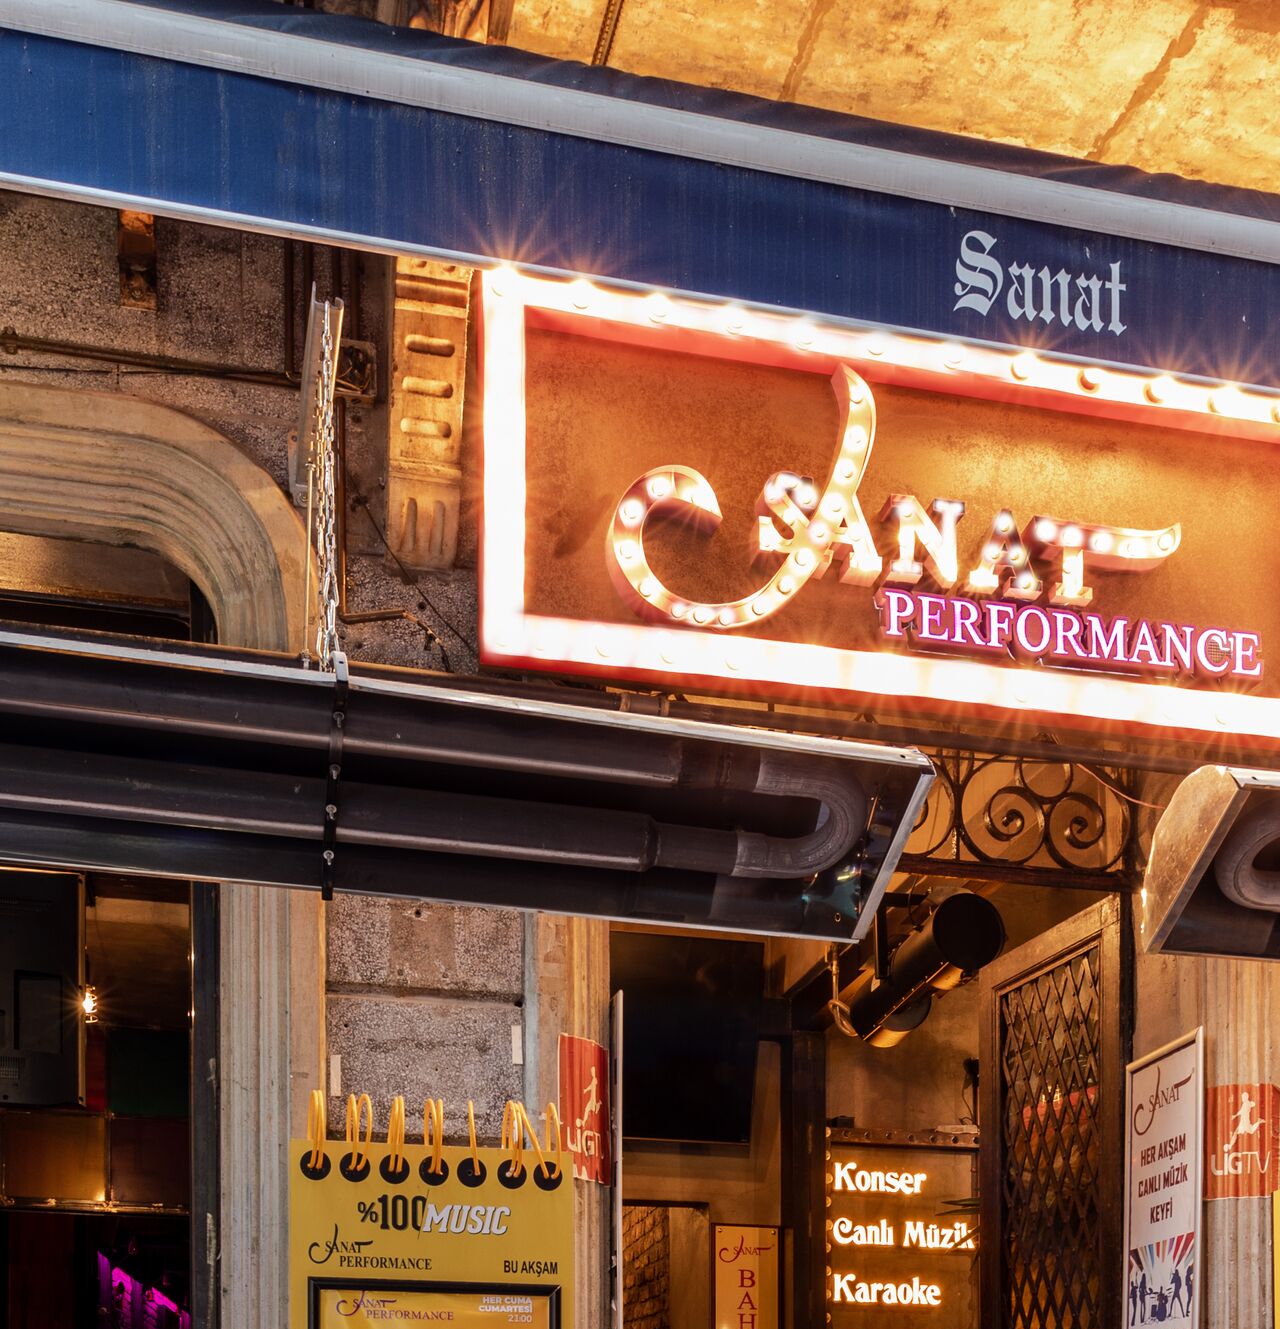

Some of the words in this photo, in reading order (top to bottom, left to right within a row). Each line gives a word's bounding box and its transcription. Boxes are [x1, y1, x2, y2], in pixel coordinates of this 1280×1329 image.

[953, 229, 1128, 335] Sanat
[607, 362, 1181, 628] SANAT
[884, 588, 1265, 677] PERFORMANCE
[1133, 1065, 1195, 1136] SANAT
[1140, 1145, 1156, 1167] HER
[1157, 1132, 1187, 1161] AKŞAM
[833, 1161, 927, 1194] Konser
[1138, 1175, 1161, 1198] CANLI
[1161, 1162, 1188, 1191] MÜZİK
[422, 1203, 512, 1236] MUSIC
[1149, 1200, 1173, 1225] KEYFİ
[308, 1223, 374, 1264] SANAT
[719, 1234, 772, 1263] SANAT
[832, 1217, 895, 1246] Canlı
[902, 1220, 976, 1249] Müzik
[339, 1255, 432, 1271] PERFORMANCE
[503, 1260, 518, 1274] BU
[520, 1261, 559, 1278] AKŞAM
[336, 1290, 397, 1317] SANAT
[482, 1296, 502, 1305] HER
[504, 1296, 533, 1305] CUMA
[833, 1272, 942, 1305] Karaoke
[366, 1308, 454, 1321] PERFORMANCE
[478, 1303, 533, 1313] CUMARTESİ
